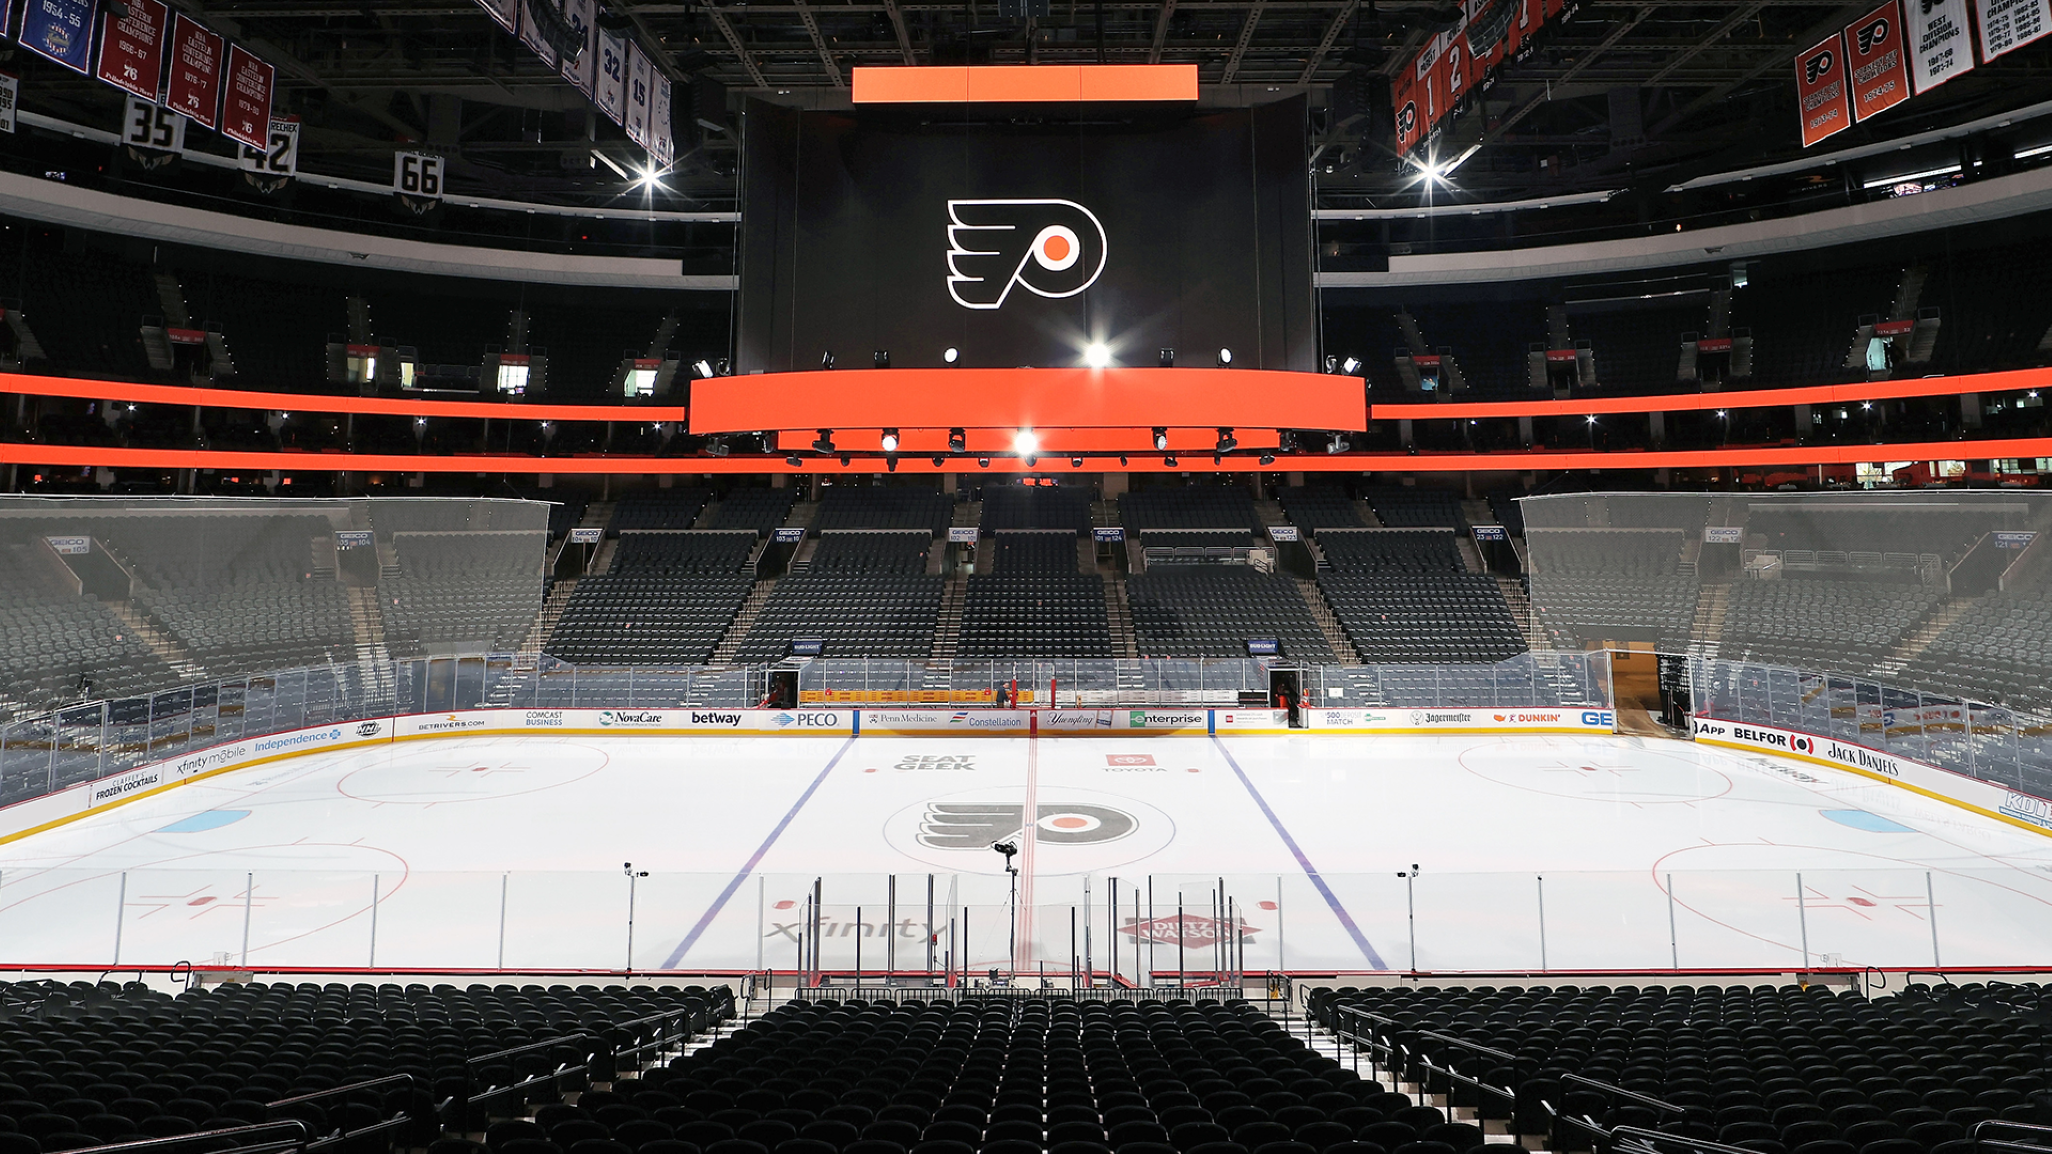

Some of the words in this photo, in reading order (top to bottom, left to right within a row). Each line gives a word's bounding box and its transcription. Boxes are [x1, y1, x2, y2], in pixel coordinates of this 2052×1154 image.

[42, 0, 81, 28] 1954-55
[128, 5, 153, 24] ASTERN
[1928, 14, 1946, 31] WEST
[117, 21, 154, 46] CHAMPIONS
[121, 15, 156, 36] NFERENCE
[1923, 21, 1952, 43] DIVISION
[1919, 27, 1960, 53] CHAMPIONS
[124, 64, 138, 81] 76
[604, 48, 620, 83] 32
[1449, 45, 1462, 94] 2
[187, 93, 200, 109] 76
[634, 79, 645, 107] 15
[1427, 75, 1434, 117] 1
[130, 102, 173, 147] 35
[243, 134, 290, 171] 42
[402, 156, 437, 193] 66
[50, 538, 84, 546] GEICO
[526, 711, 563, 719] COMCAST
[526, 718, 563, 726] BUSINESS
[614, 711, 662, 723] NovaCare
[691, 711, 742, 726] betway
[797, 713, 838, 727] PECO
[880, 713, 901, 723] Penn
[900, 713, 937, 723] Medicine
[969, 716, 1021, 727] Constellation
[1046, 712, 1094, 725] Yuengling
[1135, 714, 1202, 725] enterprise
[1517, 713, 1561, 722] DUNKIN'
[356, 722, 381, 737] NHL
[418, 720, 485, 731] BETRIVERS.COM
[254, 732, 328, 752] Independence
[1734, 727, 1787, 747] BELFOR
[176, 755, 208, 775] xfinity
[208, 746, 246, 764] mobile
[893, 762, 976, 771] GEEK
[901, 754, 976, 763] SEAT
[95, 785, 123, 801] FROZEN
[123, 774, 158, 792] COCKTAILS
[762, 916, 948, 944] xfinity
[1153, 922, 1212, 930] DIETZ
